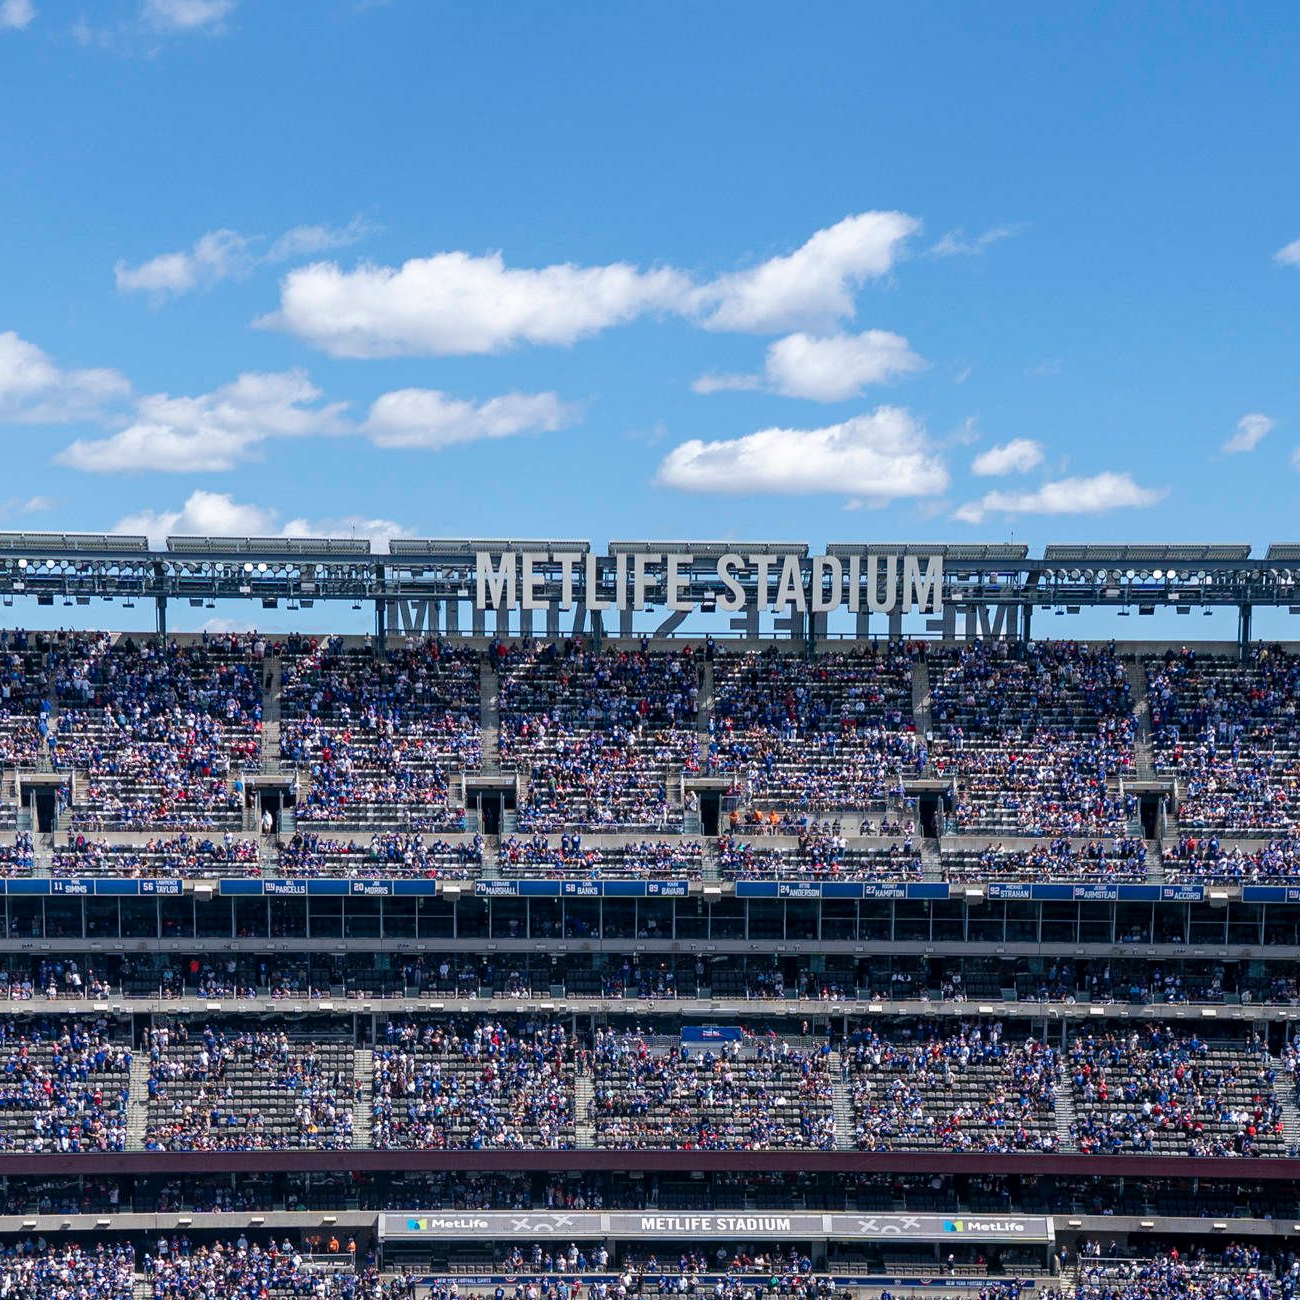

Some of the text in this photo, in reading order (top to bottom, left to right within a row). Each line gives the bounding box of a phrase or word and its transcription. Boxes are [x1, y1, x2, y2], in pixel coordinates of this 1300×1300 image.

[476, 551, 944, 614] METLIFE STADIUM
[54, 882, 63, 891] 11
[65, 885, 88, 893] SIMMS
[142, 882, 180, 894] 56 TAYLOR
[353, 882, 364, 891] 20
[364, 885, 388, 895] MORRIS
[476, 883, 517, 895] 70 MARSHALL
[565, 883, 598, 895] 58 BANKS
[648, 884, 685, 895] 89 BAVARO
[780, 885, 790, 894] 24
[789, 888, 820, 897] ANDERSON
[866, 885, 905, 897] 27 HAMPTON
[989, 886, 1029, 898] 92 STRAHAN
[1075, 887, 1085, 897] 98
[1084, 890, 1116, 899] ARMSTEAD
[432, 1219, 488, 1229] MetLife
[641, 1218, 791, 1231] METLIFE STADIUM
[967, 1222, 1024, 1232] MetLife
